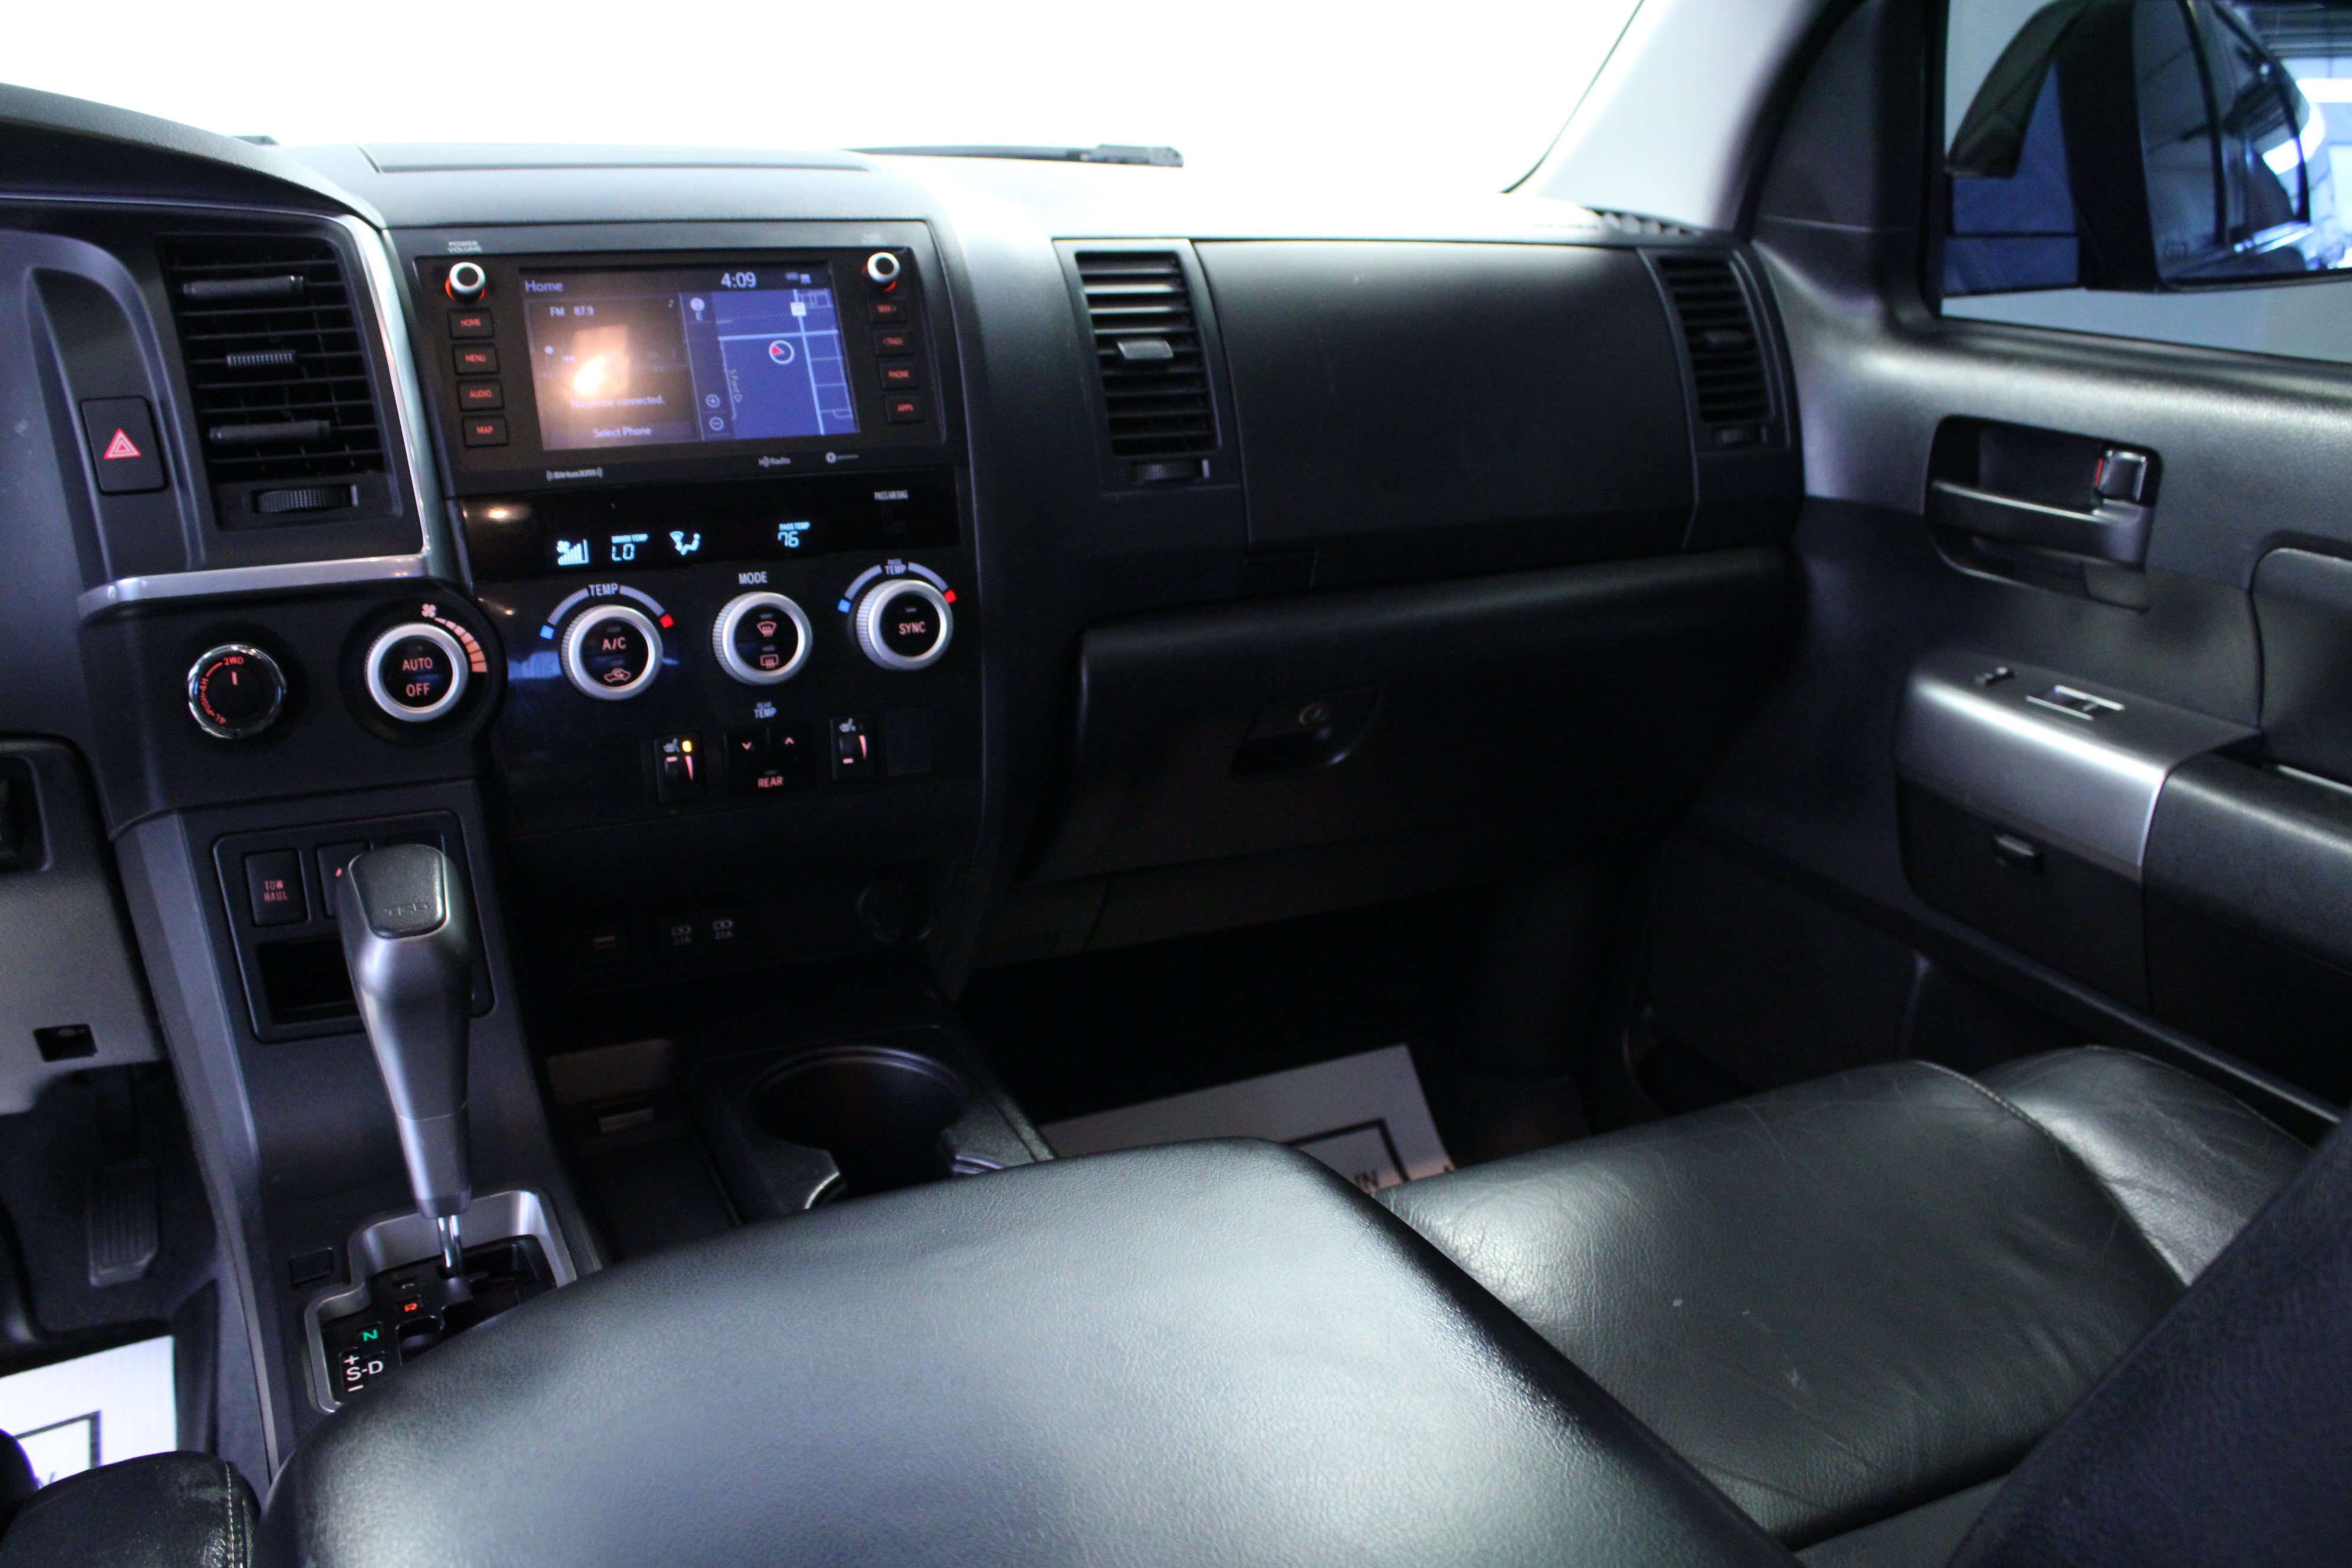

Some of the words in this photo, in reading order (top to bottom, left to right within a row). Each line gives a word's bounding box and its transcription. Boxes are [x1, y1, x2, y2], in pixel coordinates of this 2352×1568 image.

[525, 280, 563, 292] Home
[721, 272, 757, 288] 4:09
[550, 306, 566, 316] FM
[460, 318, 481, 327] HOME
[465, 353, 486, 362] MENU
[469, 390, 492, 398] AUDIO
[476, 426, 494, 434] MAP
[593, 427, 621, 438] Select
[622, 426, 652, 436] Phone
[778, 531, 799, 548] 76
[885, 564, 907, 575] TEMP
[739, 571, 768, 585] MODE
[589, 583, 618, 596] TEMP
[899, 621, 926, 635] SYNC
[602, 636, 626, 650] A/C
[223, 656, 244, 665] 2WD
[402, 658, 433, 671] AUTO
[199, 677, 208, 691] 4H
[406, 682, 430, 697] OFF
[754, 707, 777, 718] TEMP
[757, 776, 784, 788] REAR
[264, 880, 283, 890] TOW
[263, 891, 288, 902] HAUL
[363, 1329, 378, 1341] N
